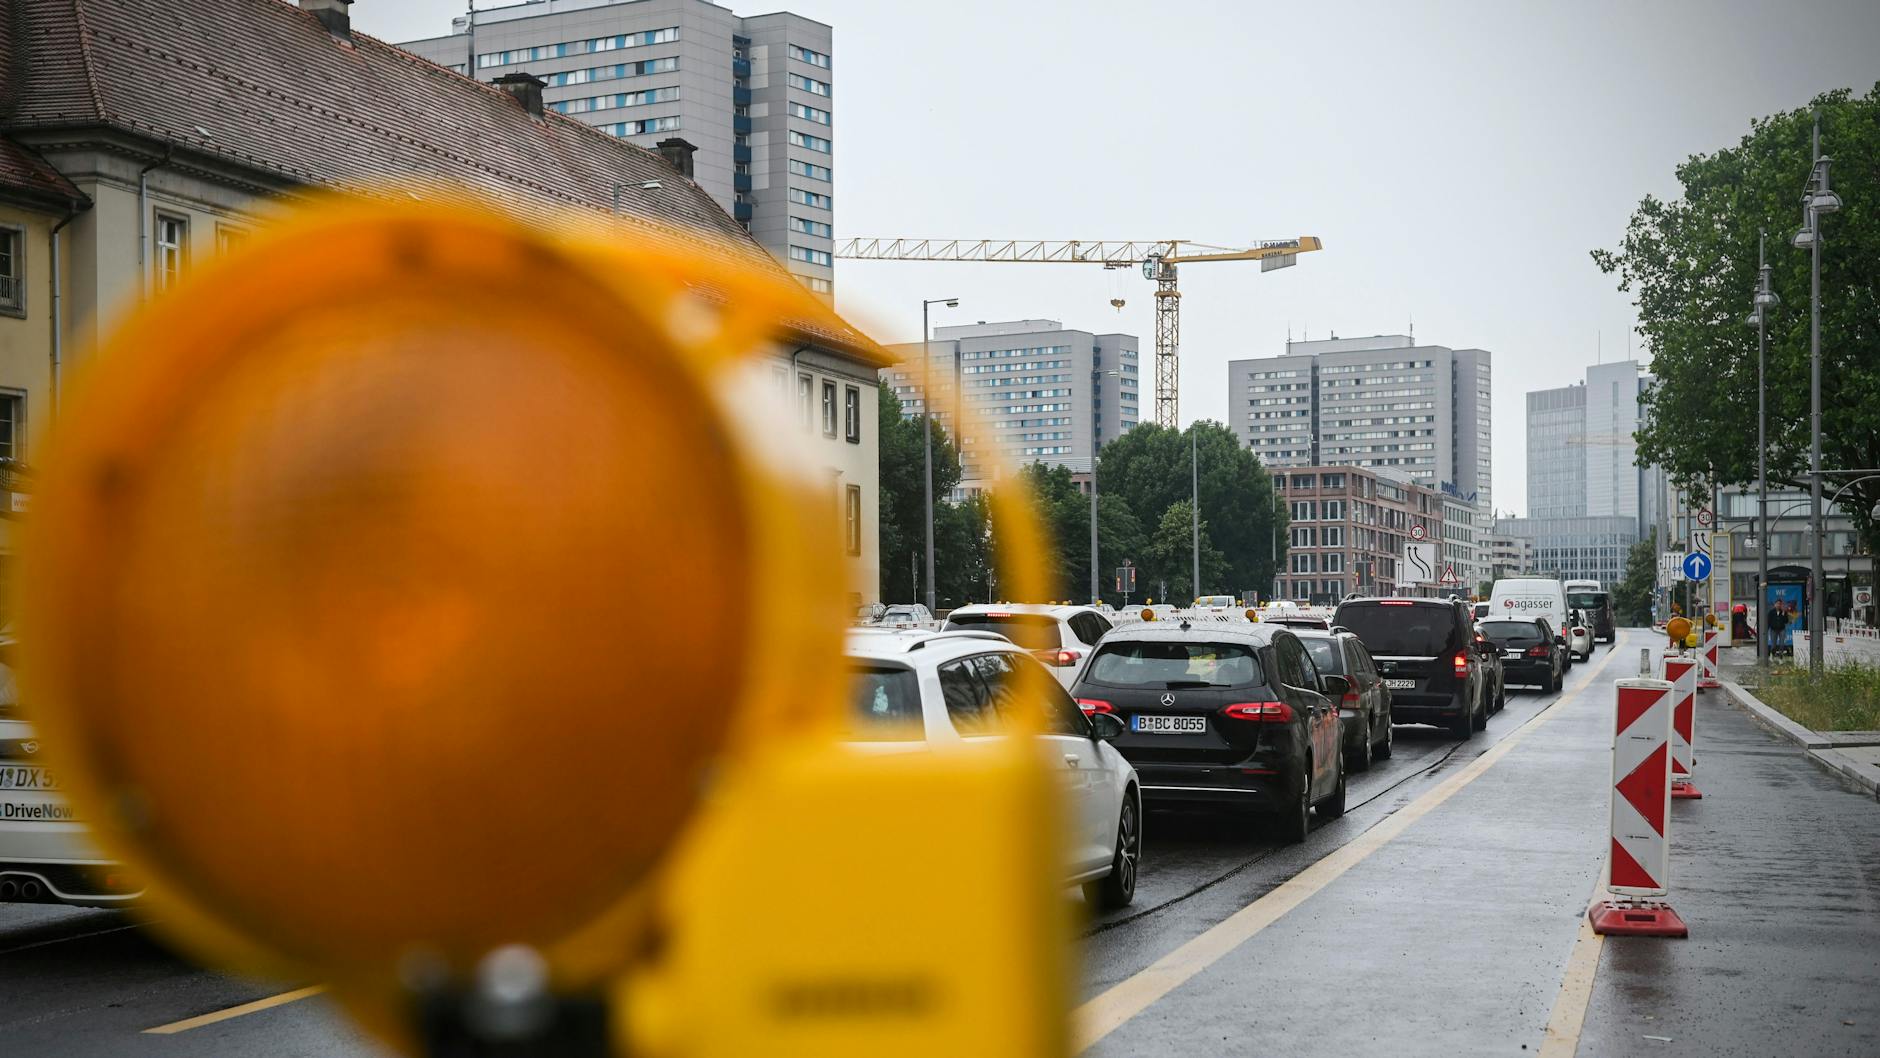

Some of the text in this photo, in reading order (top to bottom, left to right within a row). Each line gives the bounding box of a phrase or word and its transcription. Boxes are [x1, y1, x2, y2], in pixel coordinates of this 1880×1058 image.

[1700, 513, 1710, 522] 30
[1413, 529, 1422, 537] 30
[1139, 717, 1204, 730] B BC 8055
[5, 803, 73, 818] DriveNow
